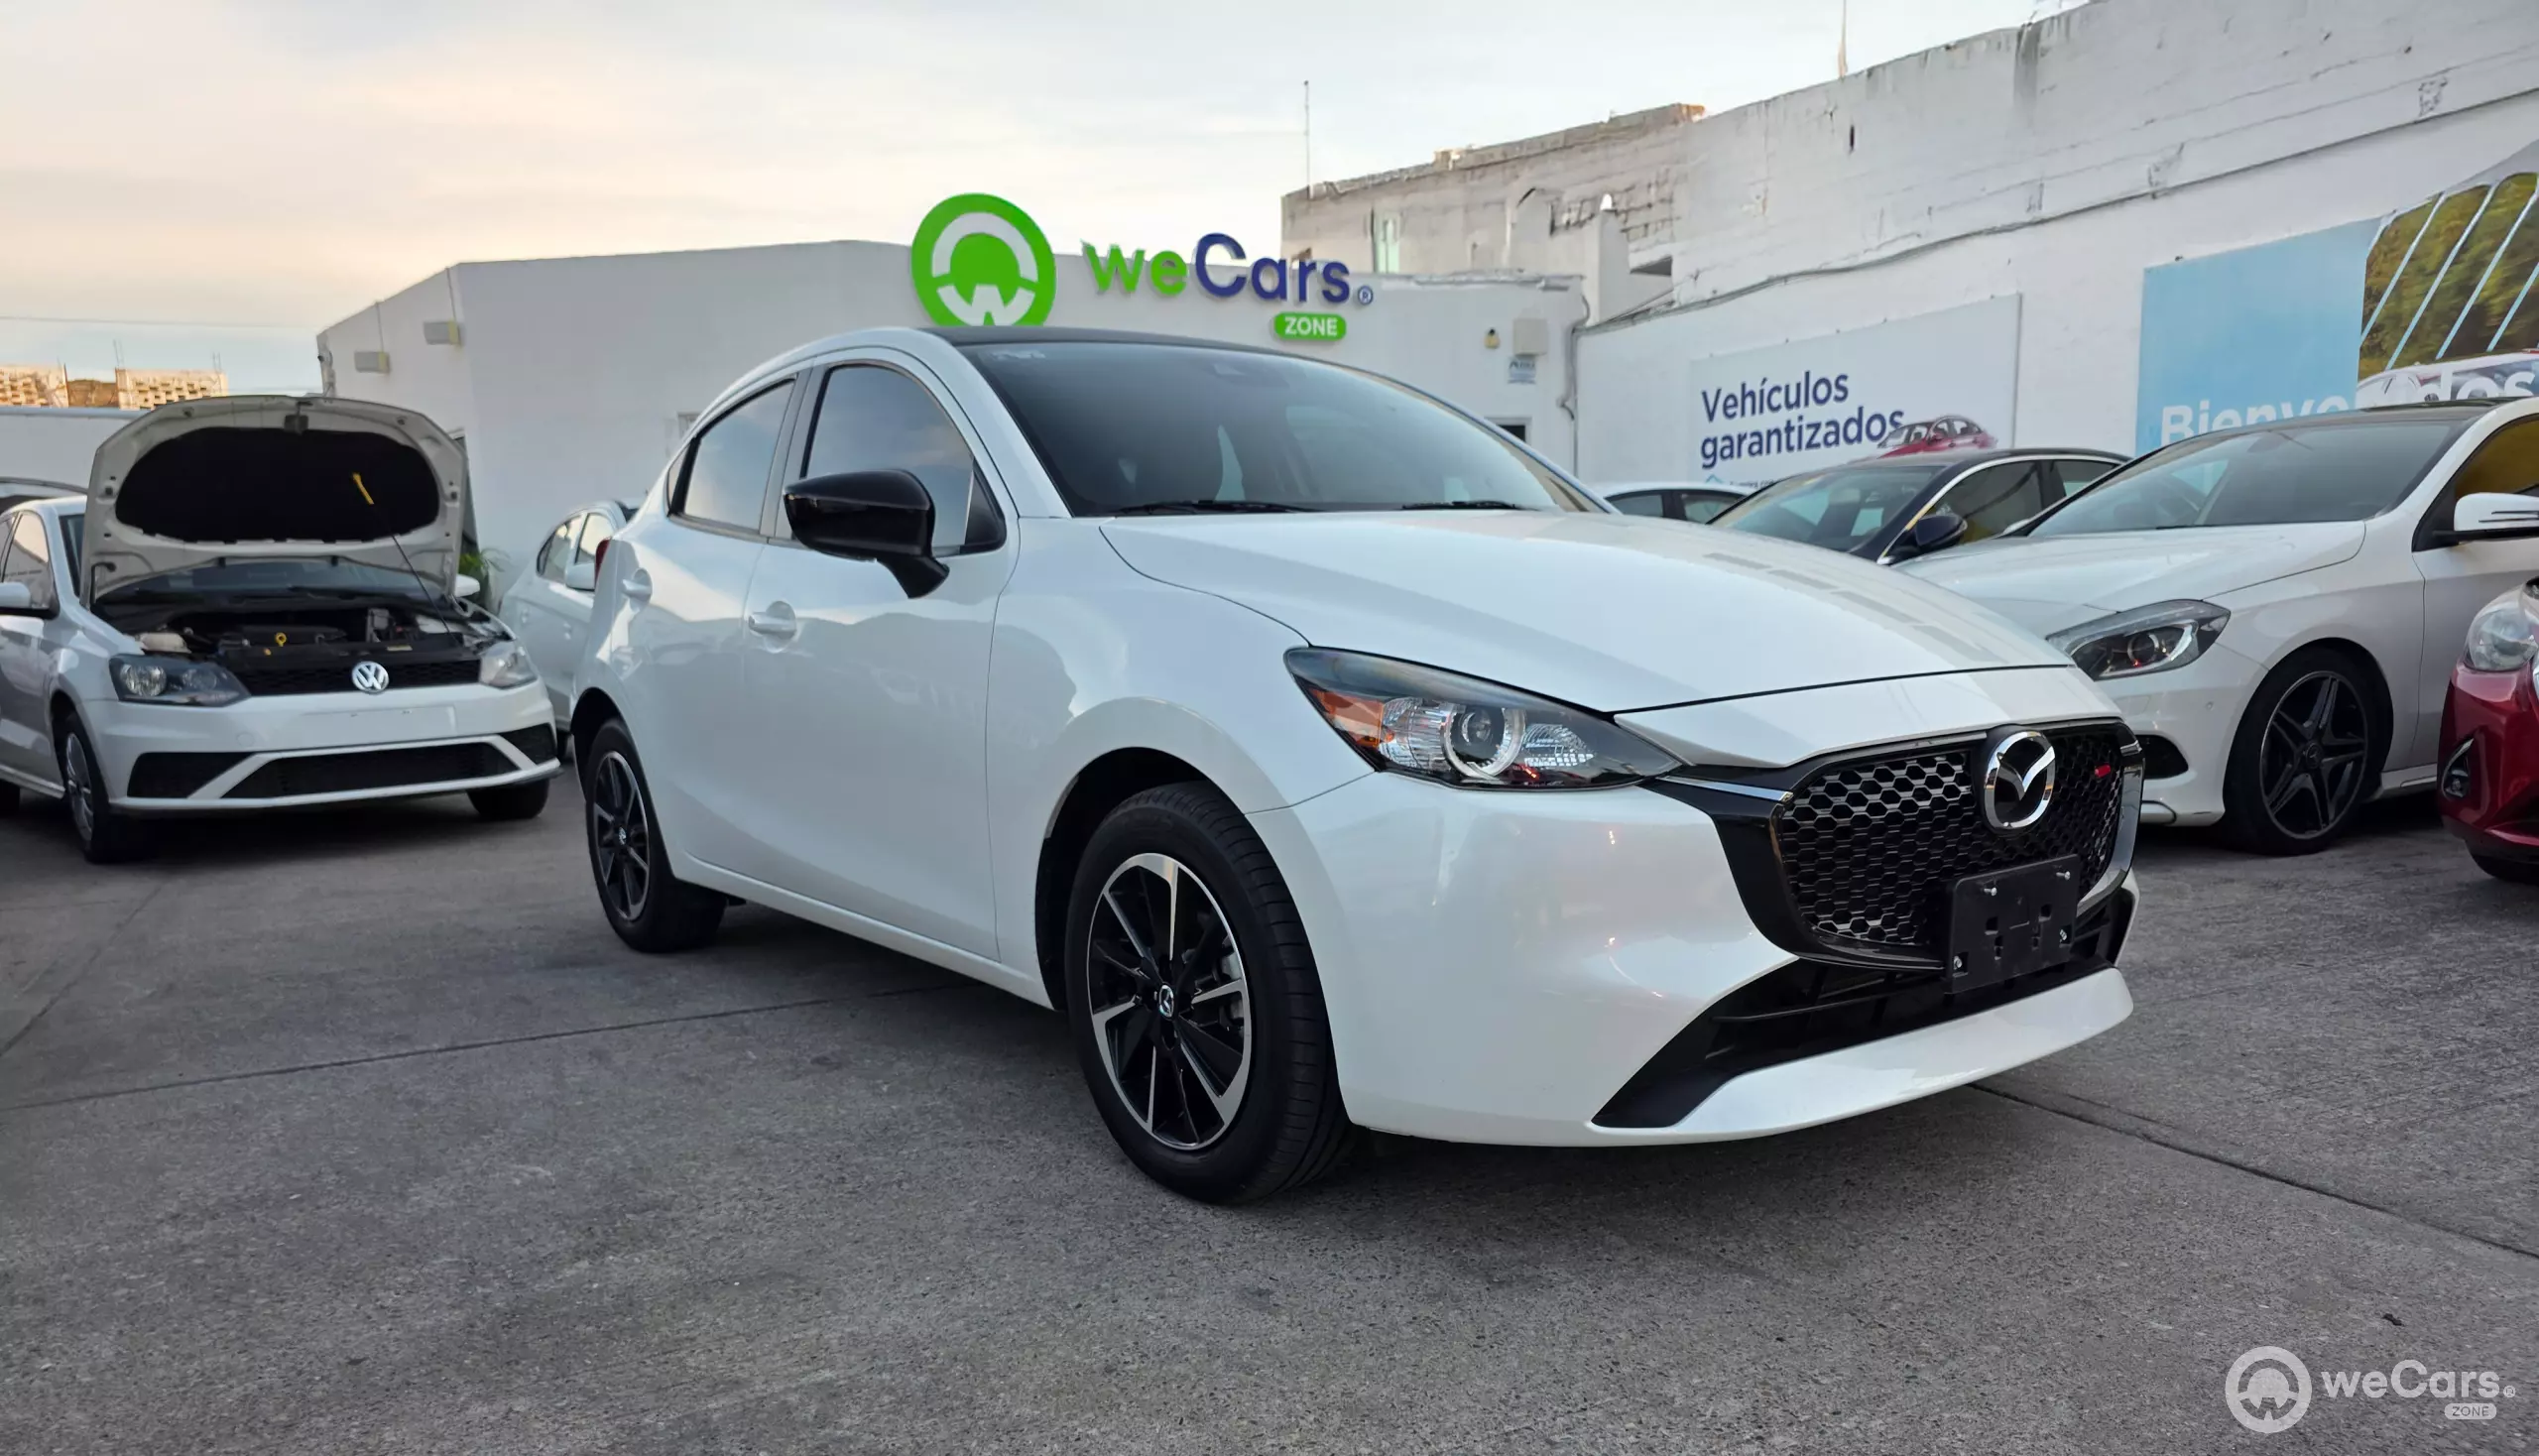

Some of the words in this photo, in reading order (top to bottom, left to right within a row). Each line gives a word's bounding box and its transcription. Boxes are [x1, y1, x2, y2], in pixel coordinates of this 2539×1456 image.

[1283, 316, 1338, 336] ZONE
[1701, 370, 1849, 423] Vehículos
[1700, 406, 1904, 469] garantizados
